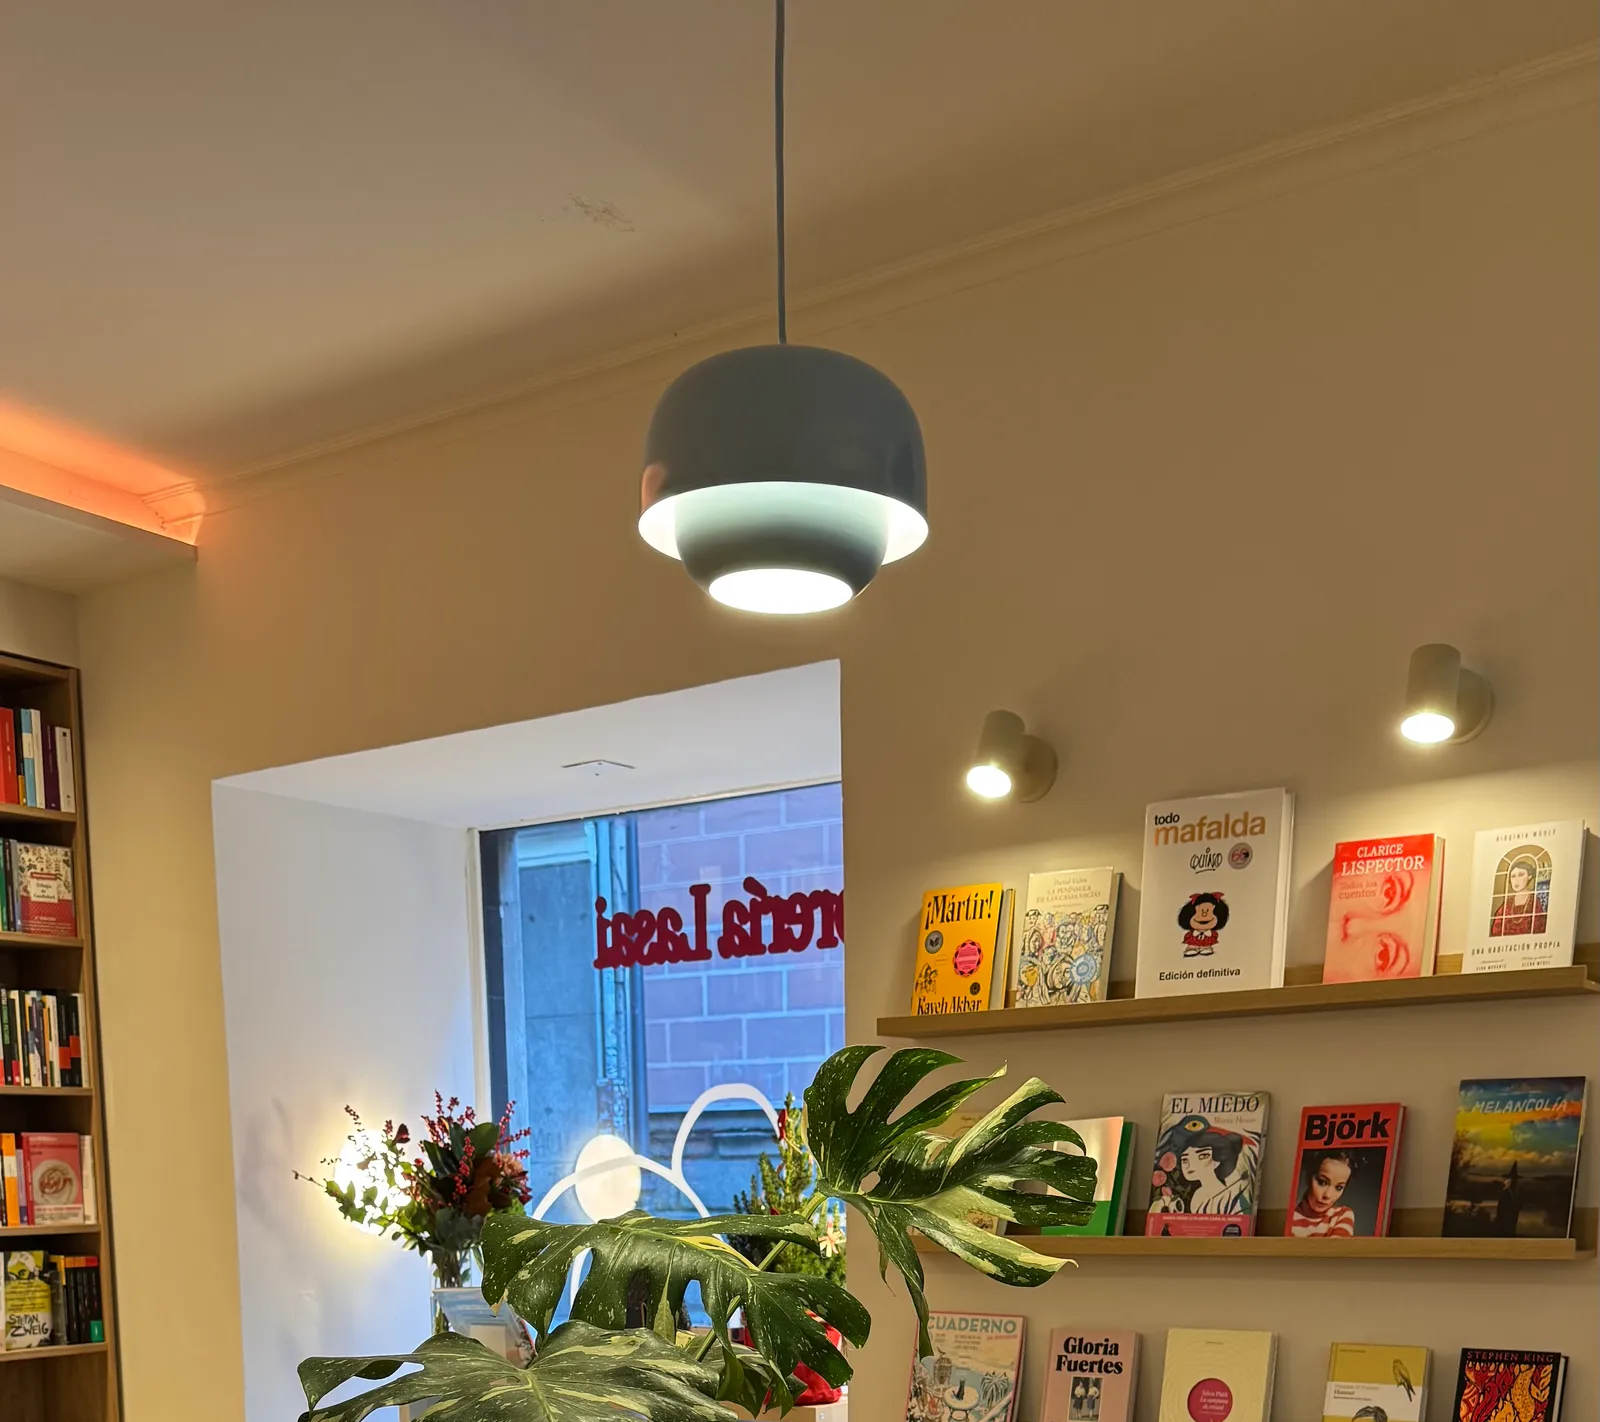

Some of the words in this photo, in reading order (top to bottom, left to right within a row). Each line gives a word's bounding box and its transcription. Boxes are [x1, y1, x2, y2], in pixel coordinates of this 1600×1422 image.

[1154, 812, 1180, 826] todo
[1154, 811, 1266, 847] mafalda
[1357, 843, 1404, 858] CLARICE
[1341, 855, 1425, 877] LISPECTOR
[1339, 888, 1377, 900] cuentos
[1341, 881, 1363, 890] Todos
[1365, 880, 1377, 889] los
[924, 890, 994, 930] ¡Mártir!
[1471, 948, 1485, 956] UNA
[1488, 942, 1531, 954] HABITACIÓN
[1534, 941, 1561, 950] PROPIA
[1159, 970, 1194, 981] Edición
[1196, 968, 1241, 979] definitiva
[1171, 1097, 1195, 1114] EL
[1198, 1096, 1260, 1114] MIEDO
[1471, 1096, 1569, 1114] MELANCOLÍA
[1305, 1111, 1391, 1146] Björk
[10, 1324, 49, 1337] ZWEIG
[928, 1316, 1017, 1334] CUADERNO
[1063, 1336, 1120, 1356] Gloria
[1055, 1354, 1123, 1375] Fuertes
[1467, 1351, 1519, 1361] STEPHEN
[1523, 1352, 1554, 1362] KING
